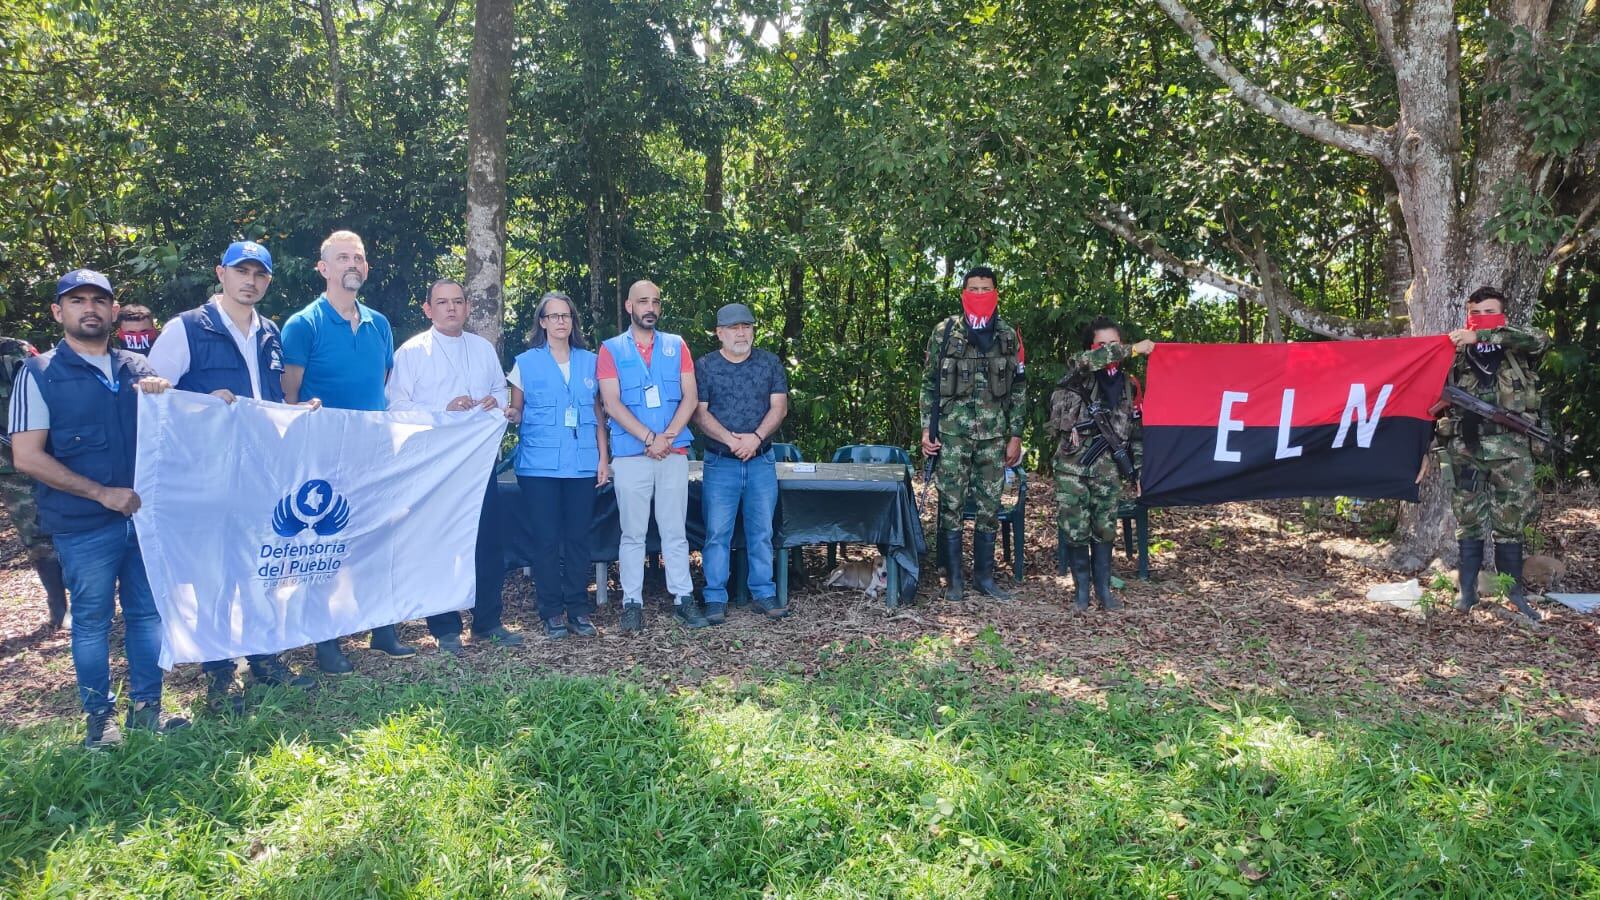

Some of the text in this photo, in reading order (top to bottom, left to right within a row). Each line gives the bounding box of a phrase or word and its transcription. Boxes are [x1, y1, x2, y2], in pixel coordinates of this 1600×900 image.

[124, 334, 150, 350] ELN
[1213, 383, 1394, 463] ELN
[258, 558, 341, 577] del Pueblo
